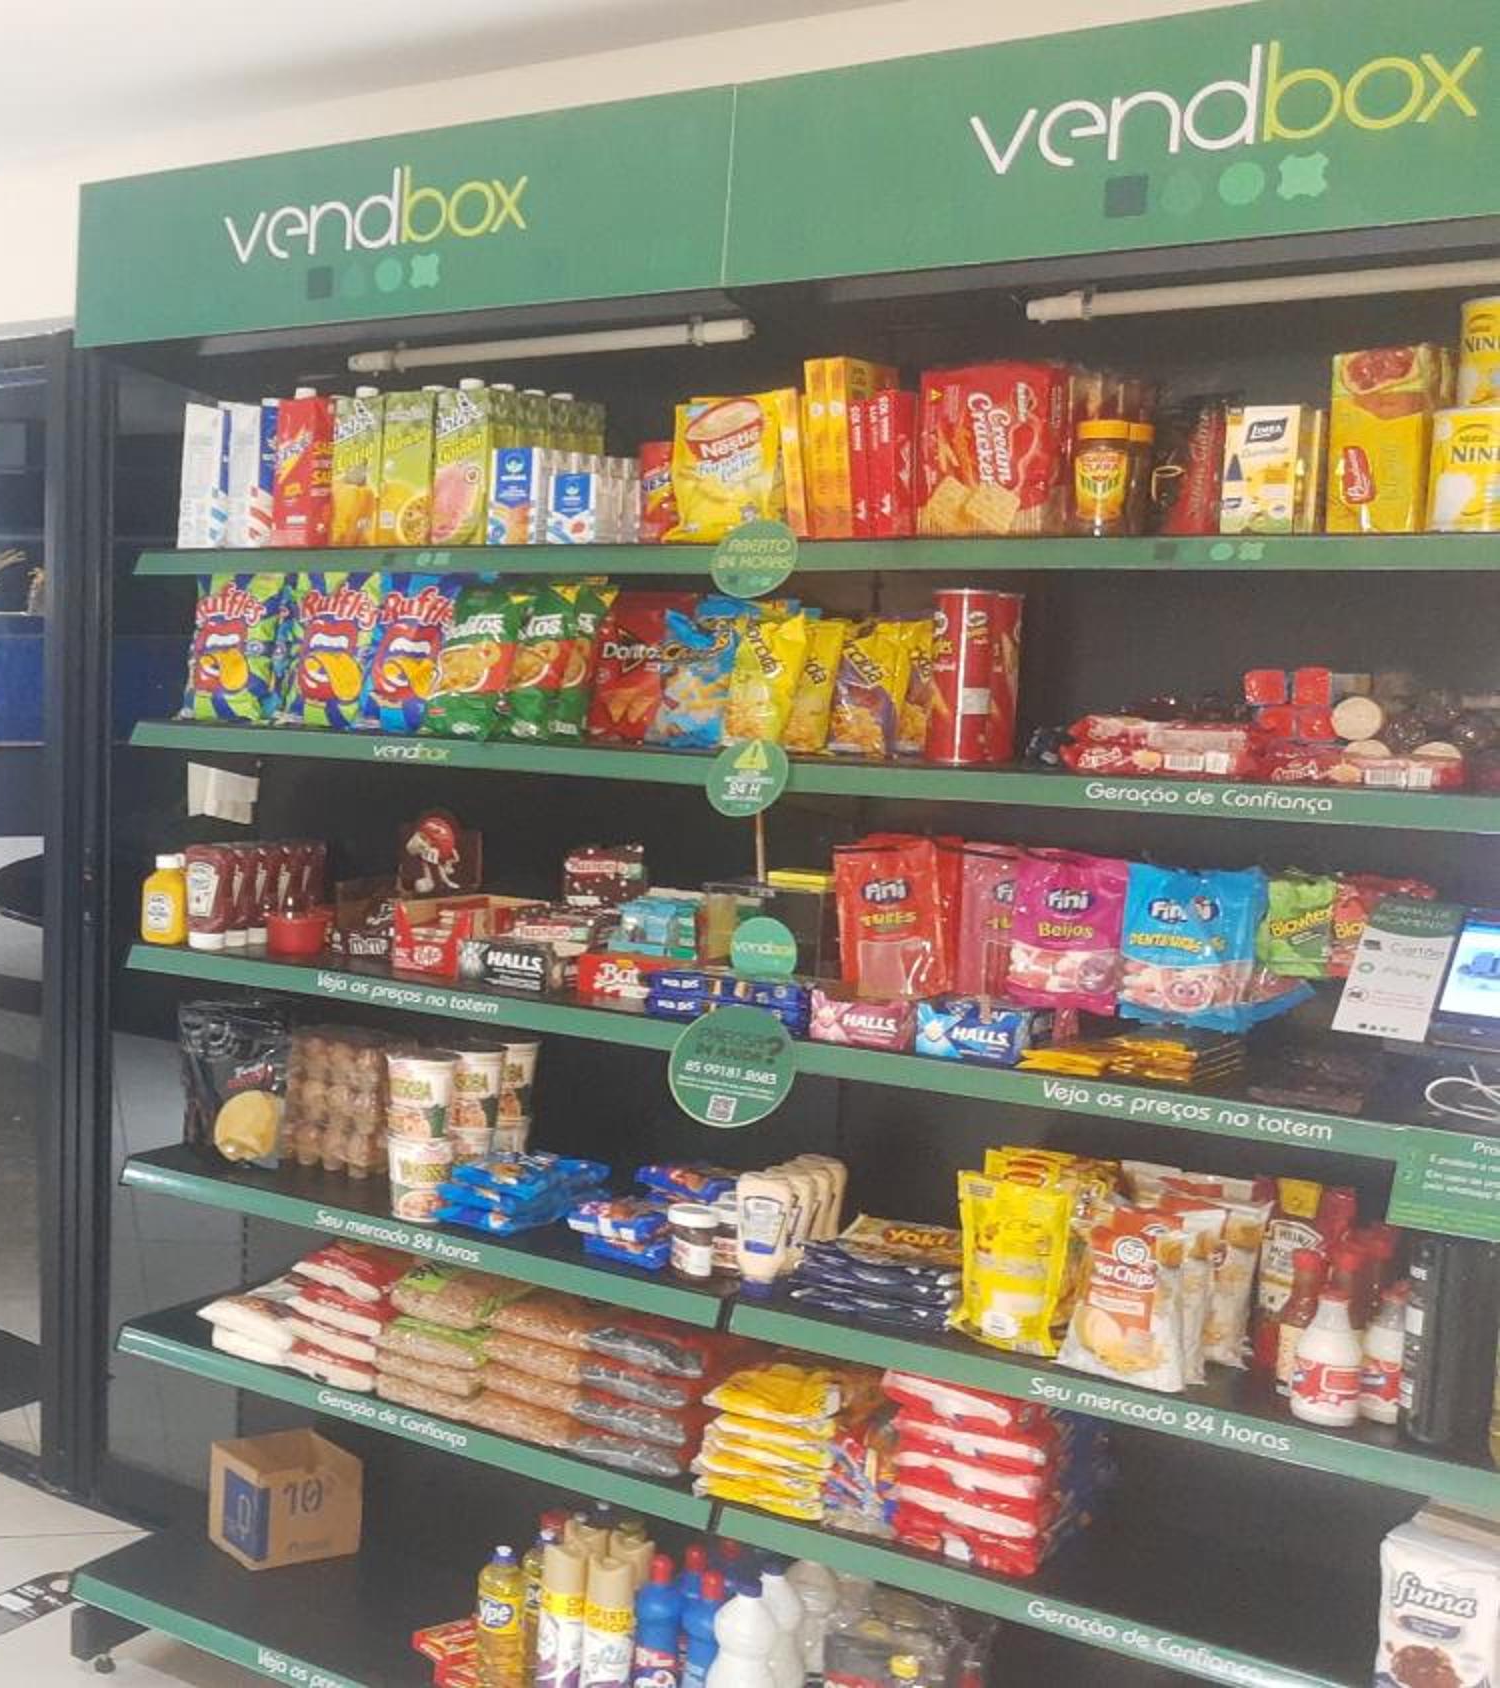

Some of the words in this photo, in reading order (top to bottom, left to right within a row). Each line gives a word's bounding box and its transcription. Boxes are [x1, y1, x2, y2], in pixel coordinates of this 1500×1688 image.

[970, 40, 1483, 175] vendbox
[225, 164, 528, 265] vendbox
[1084, 781, 1179, 805] Geração
[1185, 788, 1215, 806] de
[1220, 788, 1334, 815] Confiança
[1037, 922, 1094, 941] Beijos
[486, 949, 544, 974] HALLS
[317, 971, 348, 993] Veja
[350, 980, 369, 993] os
[371, 985, 424, 1005] preços
[426, 993, 448, 1007] no
[450, 996, 500, 1015] totem
[841, 1013, 899, 1034] HALLS
[951, 1027, 1011, 1048] HALLS
[1043, 1080, 1089, 1106] Veja
[1096, 1091, 1124, 1108] os
[1129, 1095, 1212, 1122] preços
[1217, 1109, 1250, 1127] no
[1256, 1110, 1333, 1141] totem
[315, 1209, 343, 1230] Seu
[345, 1219, 411, 1246] mercado
[411, 1232, 435, 1252] 24
[436, 1238, 482, 1264] horas
[317, 1389, 376, 1426] Geração
[378, 1407, 398, 1427] de
[399, 1414, 469, 1451] Confiança
[1028, 1376, 1072, 1402] Seu
[1076, 1391, 1178, 1427] mercado
[1183, 1411, 1216, 1436] 24
[1221, 1420, 1293, 1454] horas
[1389, 1571, 1477, 1619] finna
[1027, 1600, 1117, 1639] Geração
[1121, 1628, 1151, 1649] de
[289, 1665, 309, 1682] os
